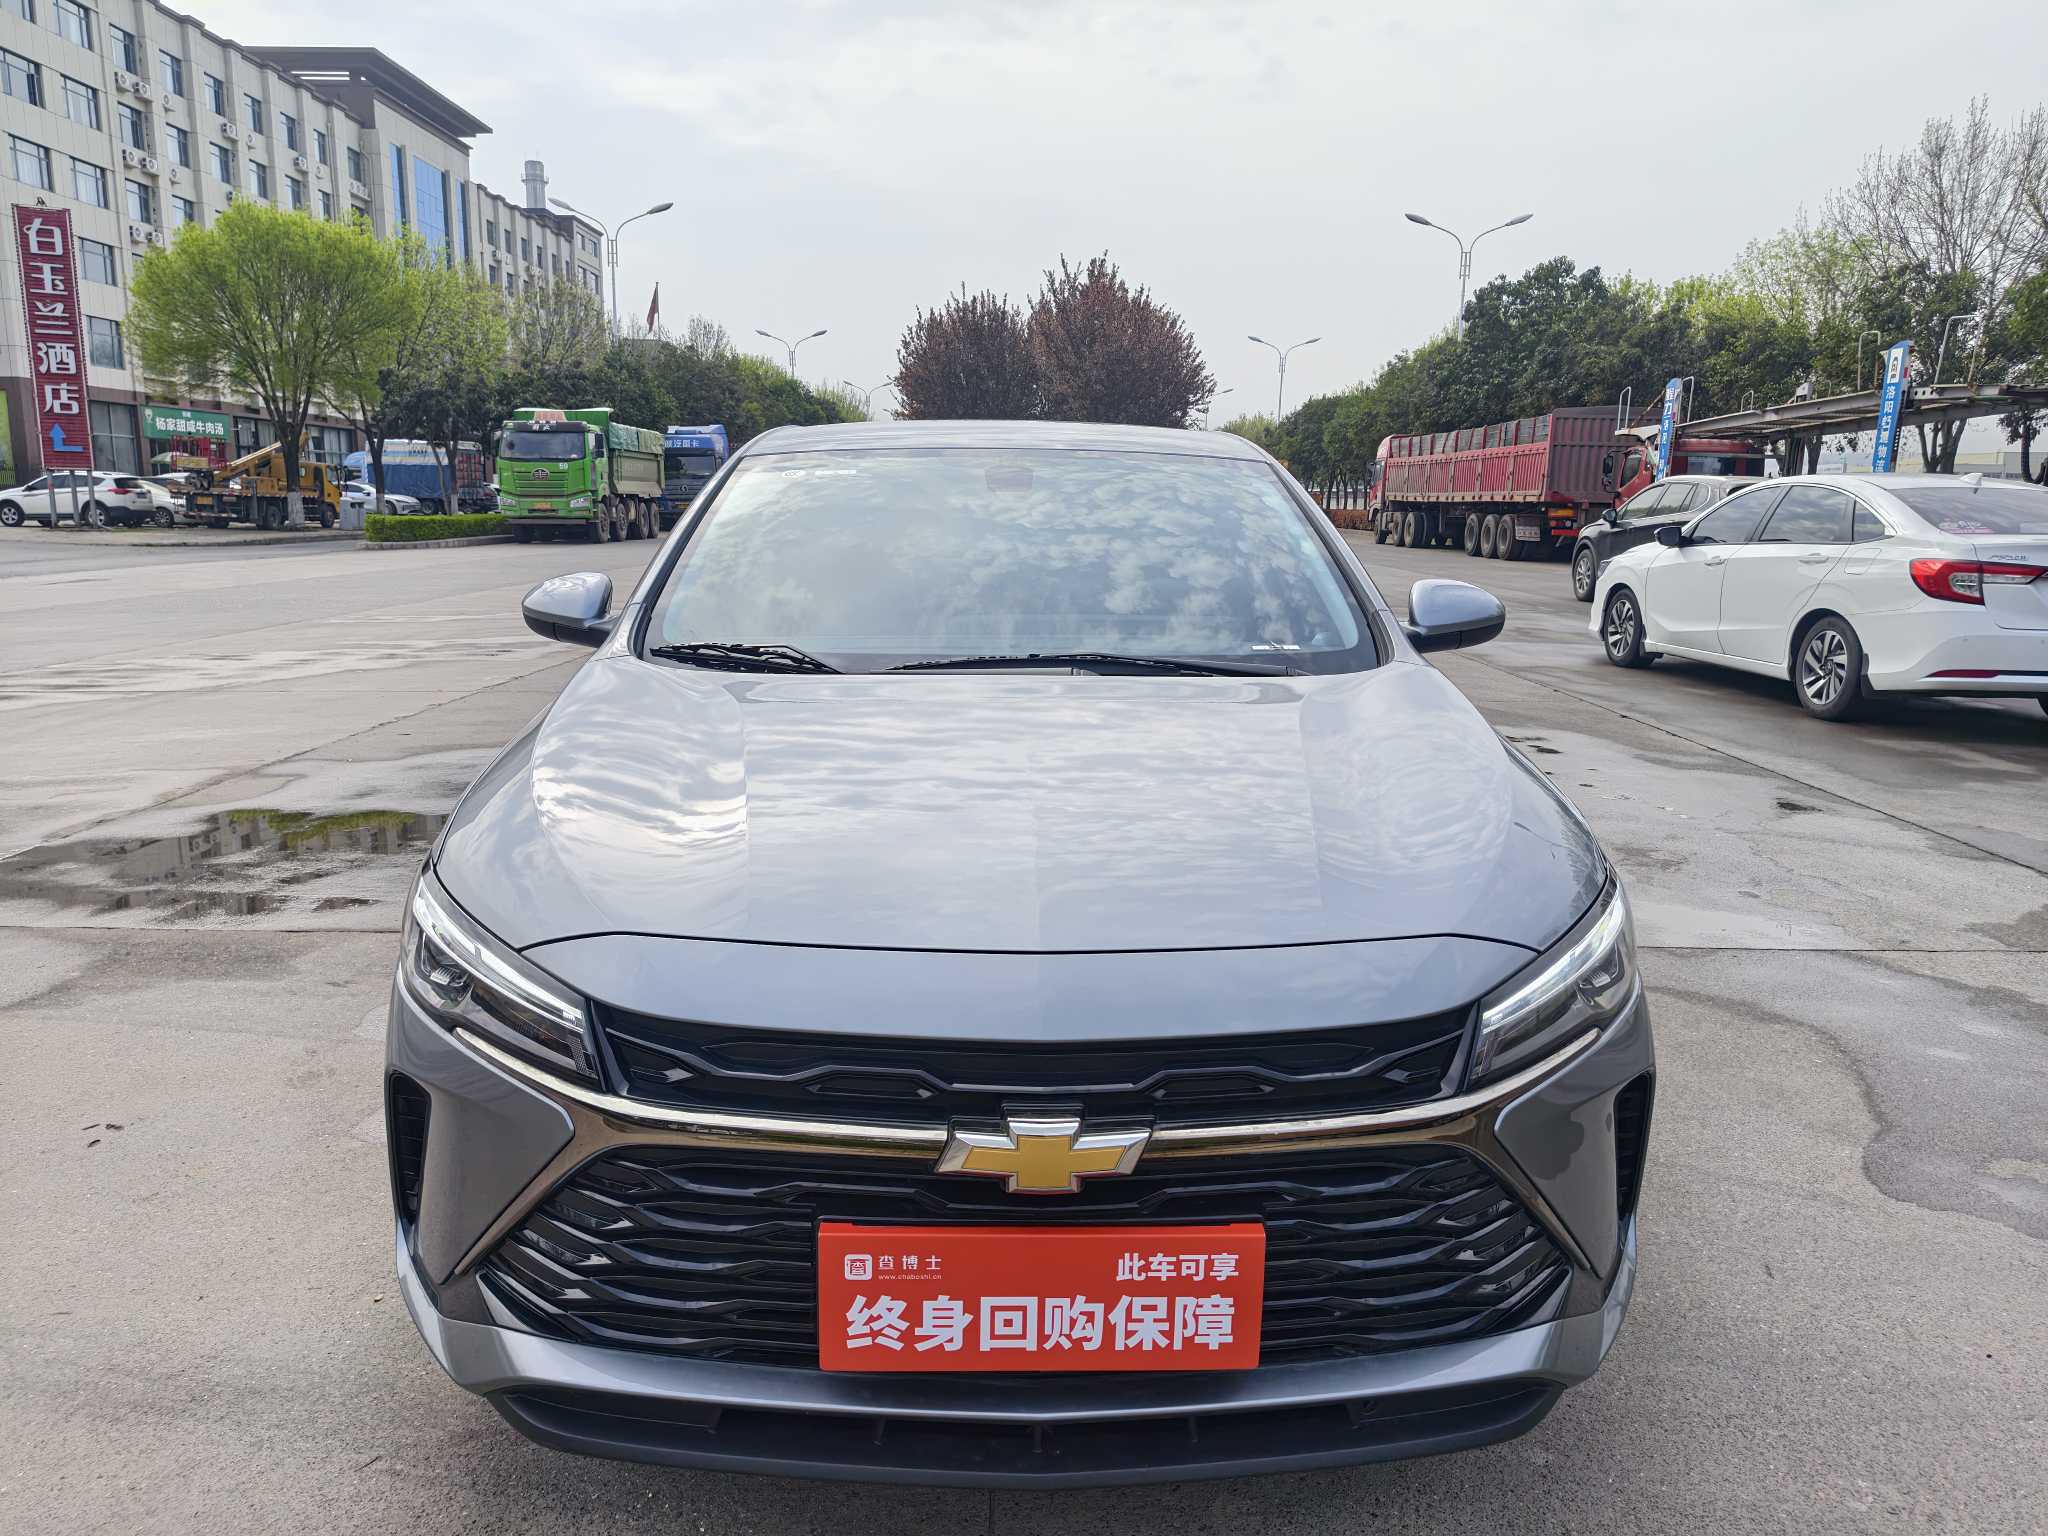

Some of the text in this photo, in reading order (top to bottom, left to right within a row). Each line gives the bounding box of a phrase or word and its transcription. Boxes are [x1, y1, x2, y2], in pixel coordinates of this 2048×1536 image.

[24, 218, 80, 415] 白玉兰酒店
[878, 1255, 942, 1270] 查博士
[1116, 1252, 1240, 1282] 此车可享
[845, 1294, 1236, 1351] 终身回购保障
